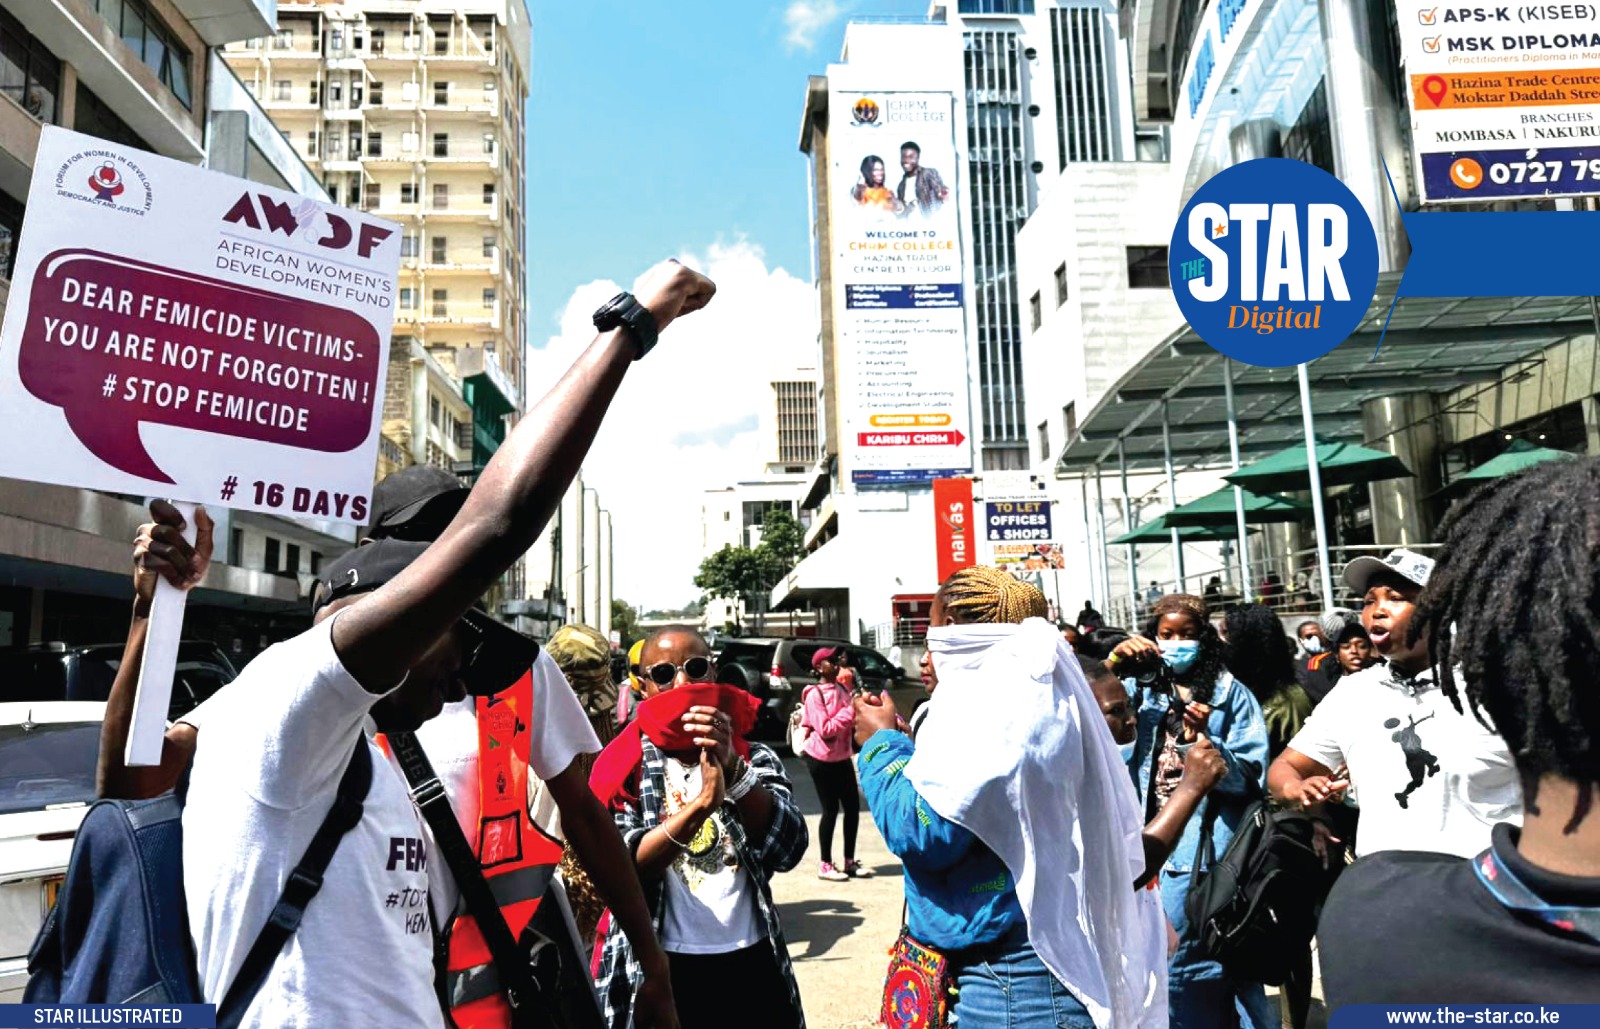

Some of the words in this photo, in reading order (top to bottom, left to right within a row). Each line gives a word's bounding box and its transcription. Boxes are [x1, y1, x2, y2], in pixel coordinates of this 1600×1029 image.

[1443, 7, 1511, 23] APS-K
[1518, 4, 1596, 24] (KISEB)
[1447, 36, 1495, 51] MSK
[1502, 33, 1600, 50] DIPLOMA
[1448, 55, 1519, 65] (Practitioners
[1522, 53, 1567, 63] Diploma
[1569, 53, 1579, 61] in
[1451, 77, 1502, 90] Hazina
[1505, 75, 1548, 88] Trade
[1551, 74, 1600, 86] Centre
[1453, 92, 1505, 104] Moktar
[1510, 89, 1567, 102] Daddah
[1570, 88, 1600, 100] Stre
[890, 100, 928, 111] CHRM
[890, 112, 946, 122] COLLEGE
[1520, 112, 1594, 124] BRANCHES
[1436, 128, 1516, 142] MOMBASA
[1534, 125, 1600, 138] NAKURU
[1489, 161, 1563, 185] 0727
[1570, 159, 1600, 181] 79
[56, 163, 69, 188] FORUM
[67, 152, 84, 166] FOR
[83, 150, 116, 159] WOMEN
[117, 155, 127, 163] IN
[126, 161, 153, 211] DEVELOPMENT
[57, 189, 102, 205] DEMOCRACY
[101, 200, 117, 209] AND
[117, 204, 145, 216] JUSTICE
[865, 230, 919, 239] WELCOME
[922, 230, 936, 238] TO
[850, 241, 888, 251] CHRM
[893, 240, 954, 250] COLLEGE
[217, 238, 300, 270] AFRICAN
[307, 257, 392, 293] WOMEN'S
[863, 254, 902, 262] HAZINA
[216, 255, 341, 299] DEVELOPMENT
[344, 286, 391, 309] FUND
[62, 277, 133, 317] DEAR
[140, 295, 256, 342] FEMICIDE
[262, 321, 364, 362] VICTIMS-
[43, 316, 98, 351] YOU
[104, 329, 154, 363] ARE
[161, 340, 213, 373] NOT
[218, 352, 358, 403] FORGOTTEN
[103, 374, 117, 398] #
[123, 376, 190, 409] STOP
[195, 388, 310, 433] FEMICIDE
[866, 434, 911, 444] KARIBU
[913, 433, 949, 444] CHRM
[220, 475, 238, 501] #
[252, 480, 284, 509] 16
[293, 488, 369, 521] DAYS
[995, 502, 1013, 512] TO
[1016, 502, 1041, 512] LET
[990, 514, 1047, 526] OFFICES
[942, 502, 966, 562] naivas
[989, 529, 1000, 540] &
[1003, 528, 1049, 540] SHOPS
